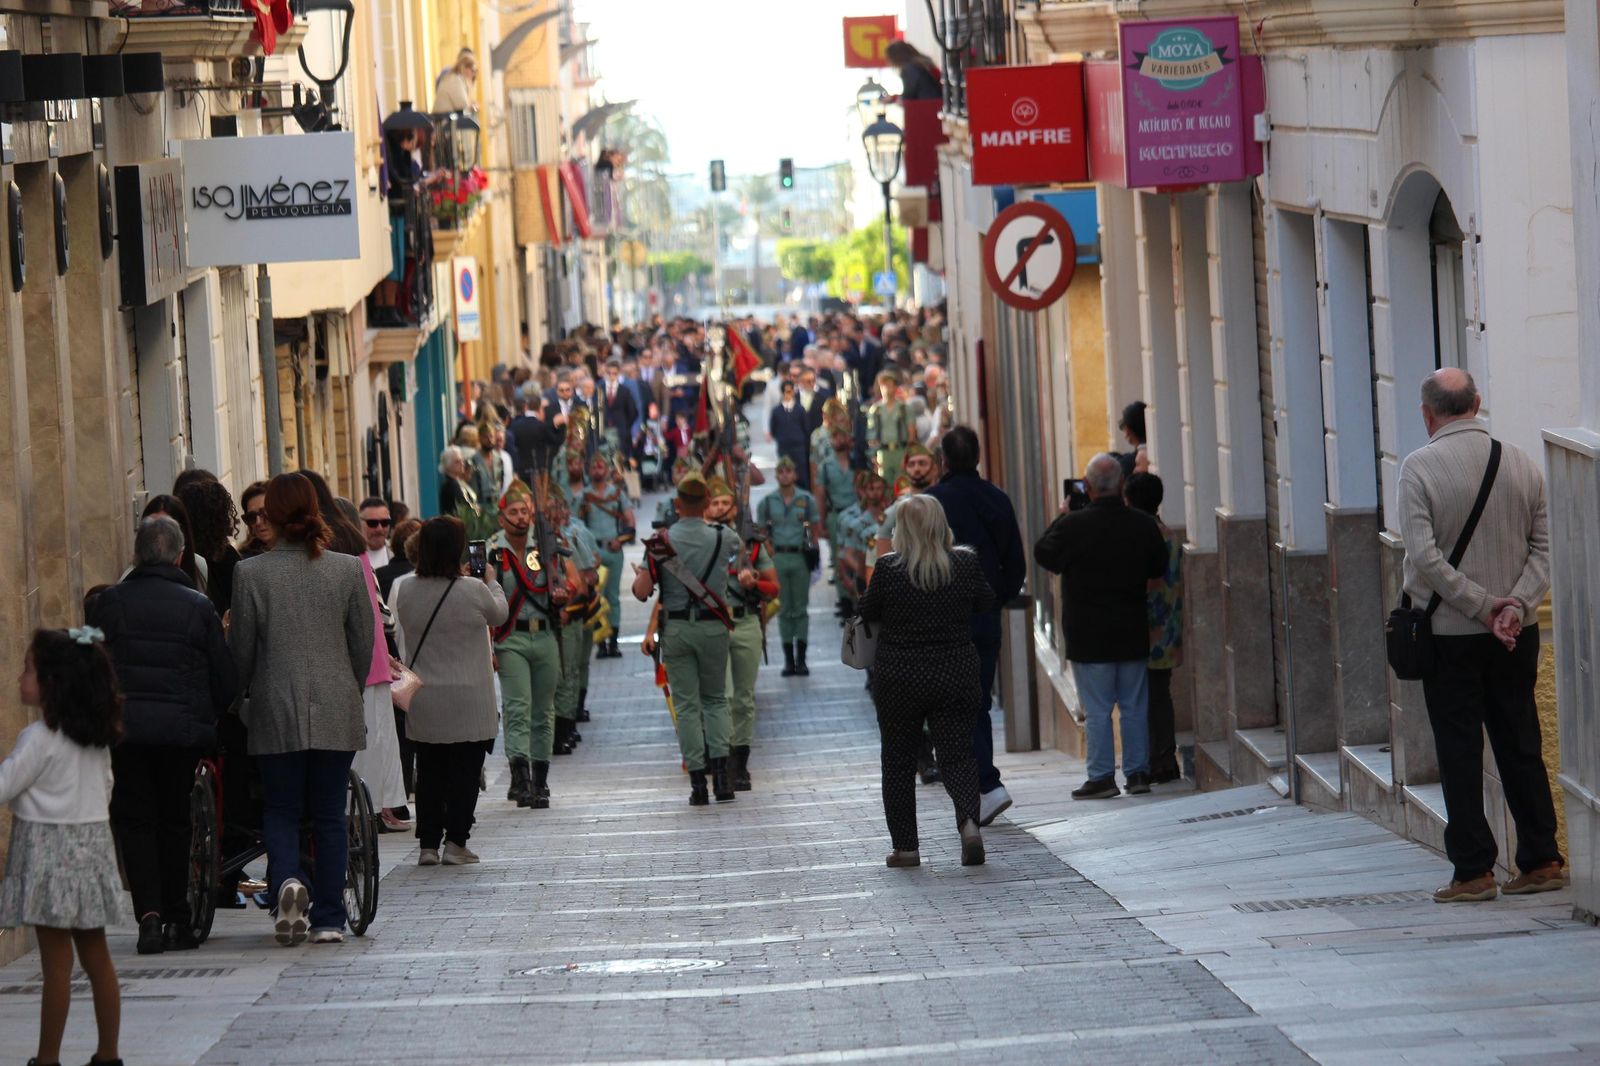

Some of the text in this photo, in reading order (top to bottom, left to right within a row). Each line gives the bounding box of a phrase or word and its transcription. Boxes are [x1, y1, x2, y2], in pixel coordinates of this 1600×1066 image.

[1158, 43, 1204, 58] MOYA
[1152, 61, 1210, 75] VARIEDADES
[1138, 114, 1231, 133] ARTÍCULOS DE REGALO
[981, 127, 1071, 147] MAPFRE
